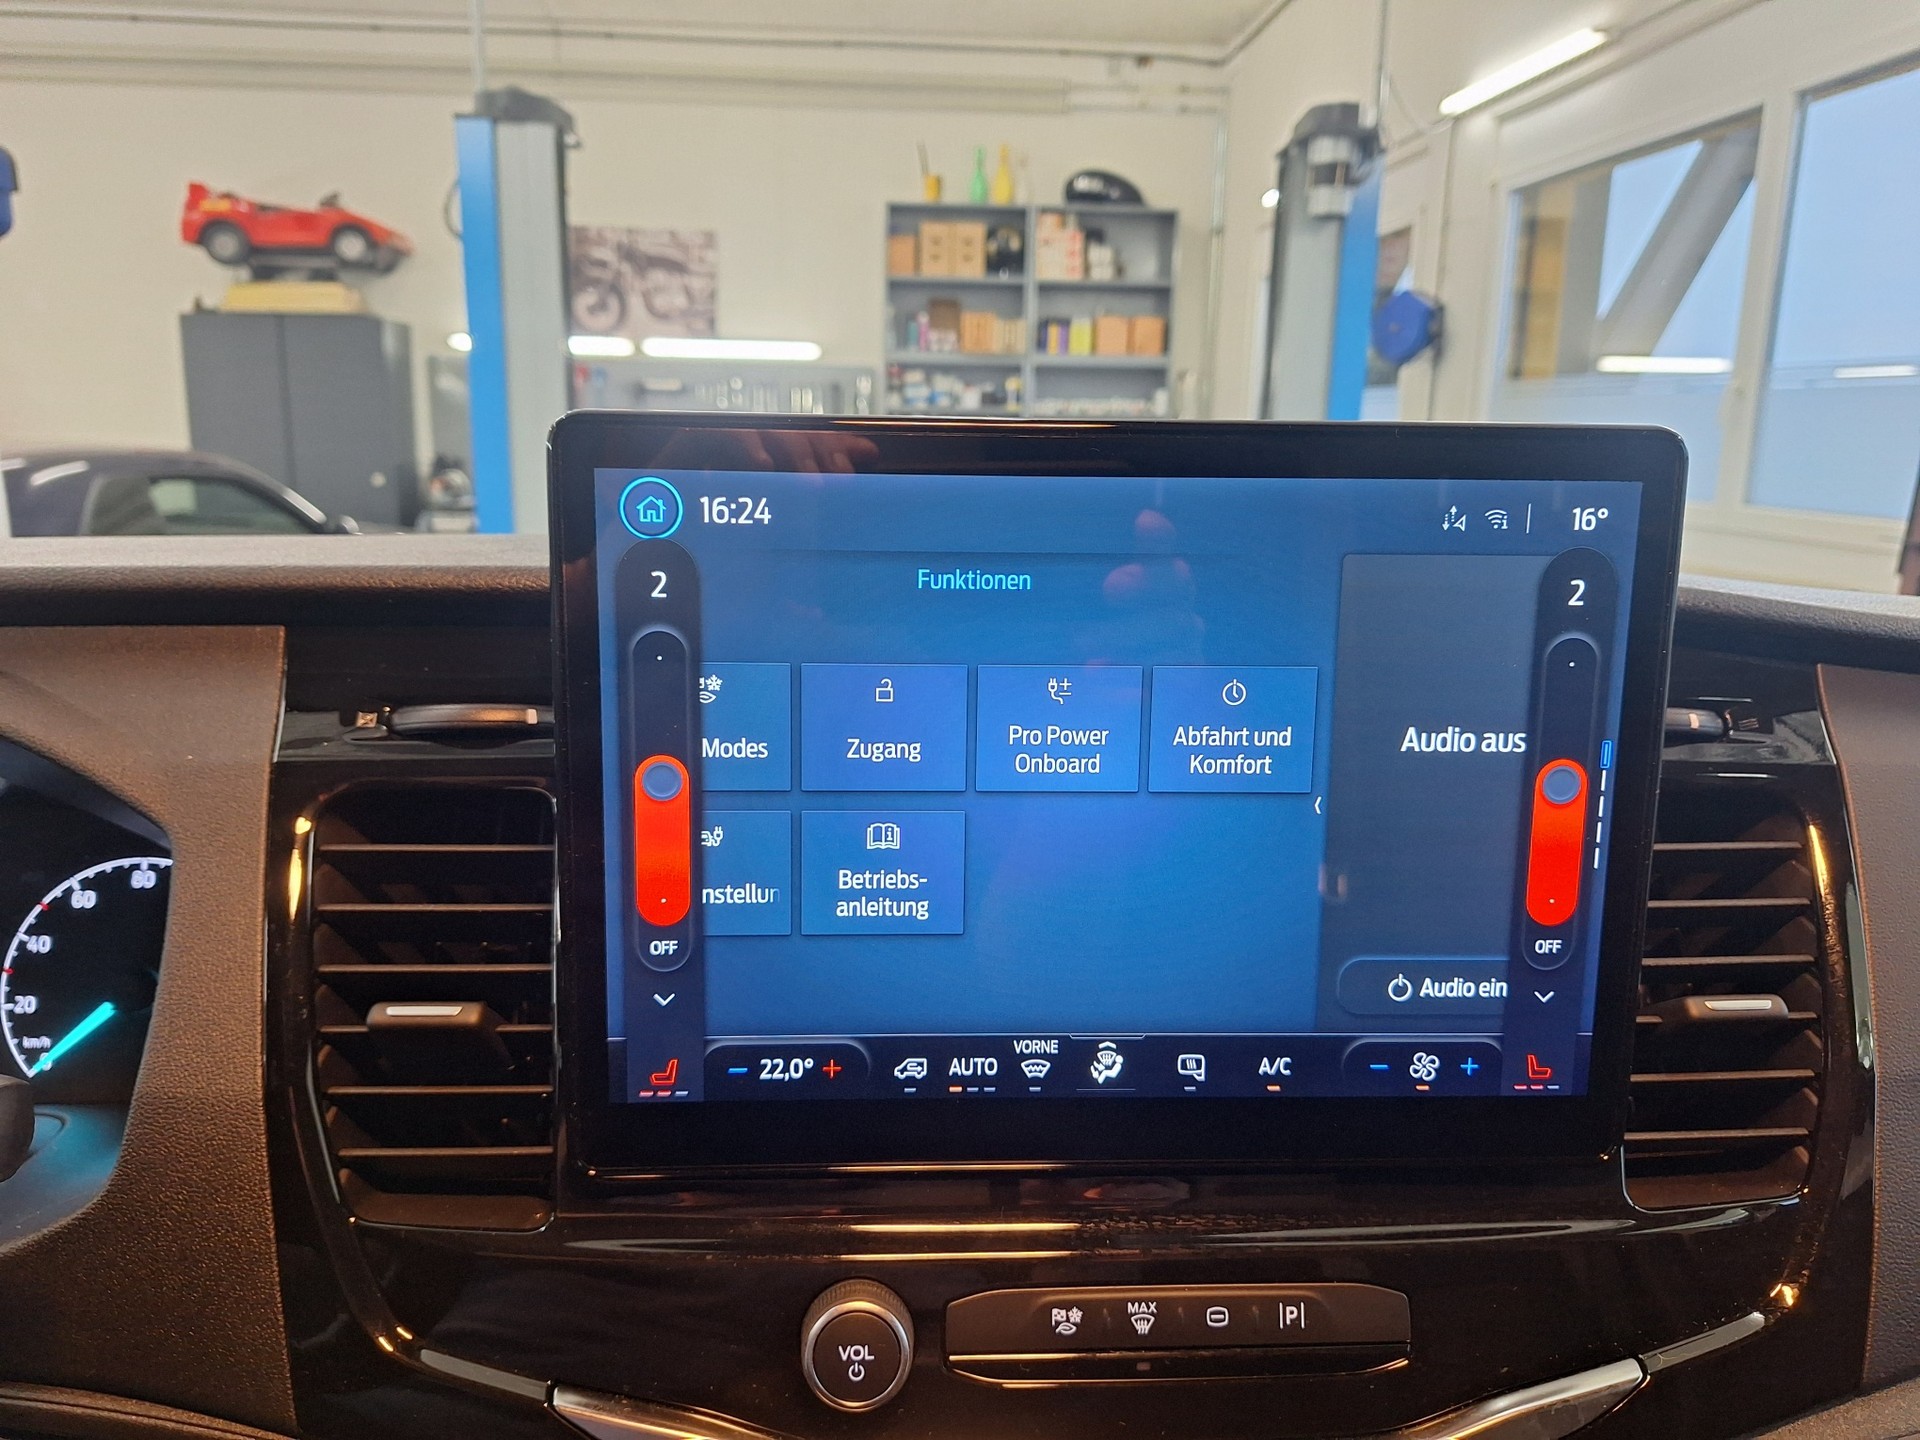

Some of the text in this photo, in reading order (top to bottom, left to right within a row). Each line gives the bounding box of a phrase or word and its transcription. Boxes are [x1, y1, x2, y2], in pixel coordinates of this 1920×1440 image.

[700, 496, 772, 526] 16:24
[650, 571, 668, 598] 2
[917, 568, 1032, 592] Funktionen
[1568, 579, 1586, 606] 2
[1009, 725, 1110, 747] Pro Power
[1173, 726, 1292, 747] Abfahrt und
[1400, 727, 1527, 753] Audio aus
[702, 737, 769, 759] Modes
[846, 738, 922, 764] Zugang
[1015, 754, 1101, 776] Onboard
[1189, 754, 1273, 776] Komfort
[838, 869, 929, 891] Betriebs-
[71, 890, 97, 909] 60
[836, 897, 930, 921] anleitung
[26, 934, 52, 954] 40
[649, 940, 679, 956] OFF
[1534, 939, 1563, 955] OFF
[1419, 977, 1508, 999] Audio ein
[13, 995, 37, 1015] 20
[1013, 1039, 1059, 1055] VORNE
[948, 1056, 999, 1077] AUTO
[1258, 1056, 1292, 1076] A/C
[1127, 1302, 1158, 1315] MAX
[838, 1345, 875, 1362] VOL
